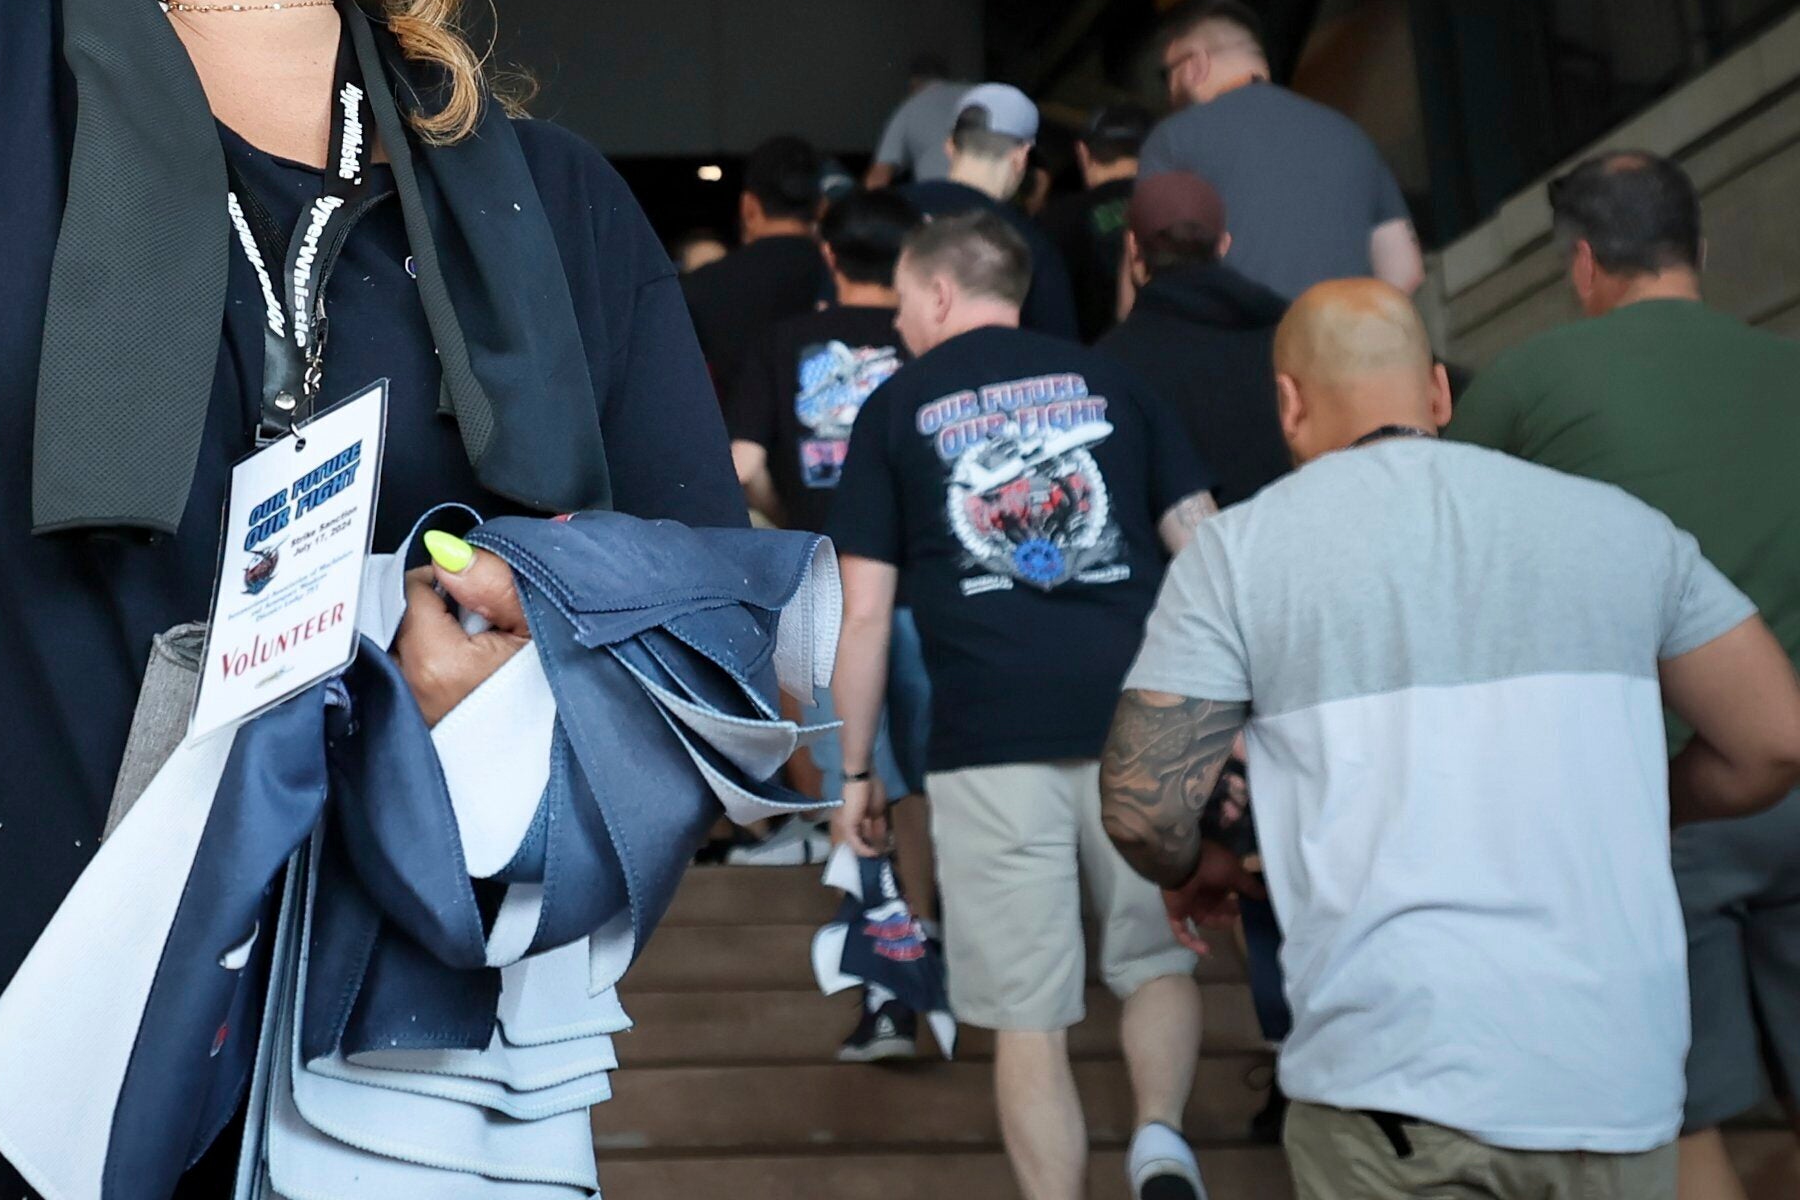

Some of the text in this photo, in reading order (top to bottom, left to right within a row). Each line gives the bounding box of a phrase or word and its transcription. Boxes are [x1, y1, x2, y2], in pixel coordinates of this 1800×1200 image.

[917, 372, 1088, 434] OUR FUTURE
[936, 395, 1108, 460] OUR FIGHT
[244, 458, 361, 552] OUR FIGHT
[248, 438, 363, 527] OUR FUTURE
[291, 506, 358, 548] Strike Sanction
[294, 543, 312, 557] July
[330, 518, 352, 537] 2024
[222, 602, 345, 680] VOLUNTEER
